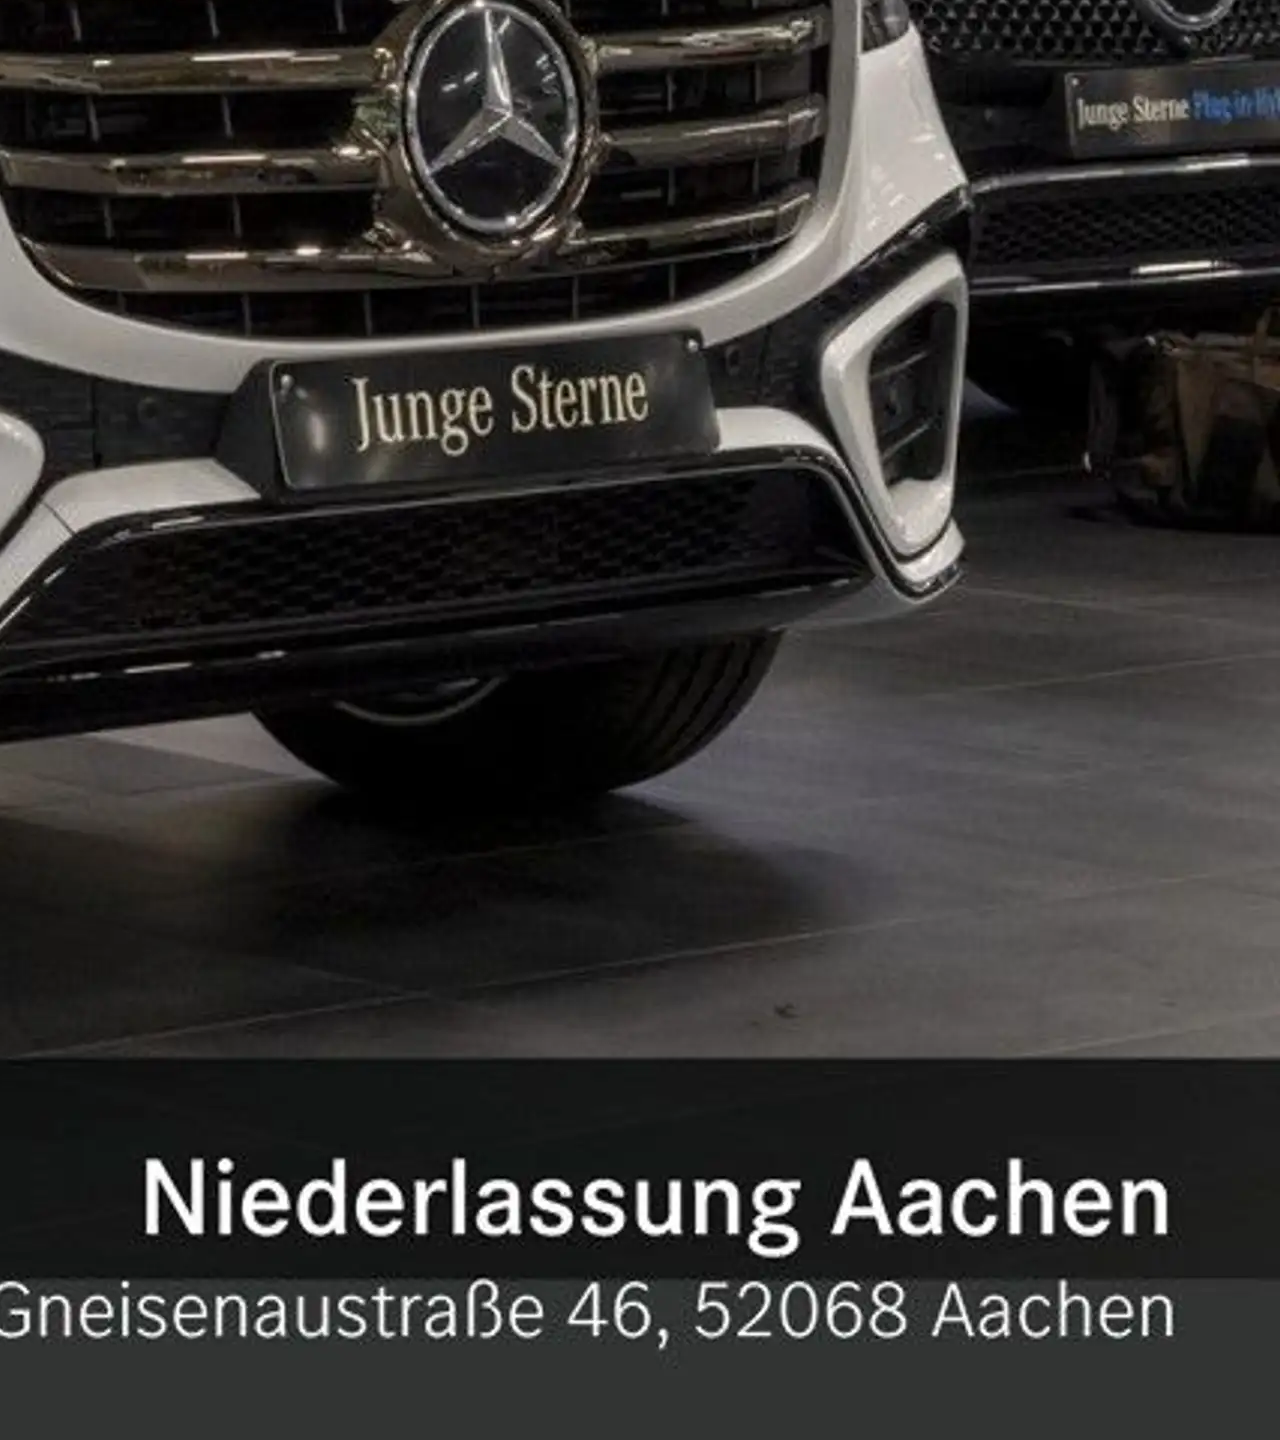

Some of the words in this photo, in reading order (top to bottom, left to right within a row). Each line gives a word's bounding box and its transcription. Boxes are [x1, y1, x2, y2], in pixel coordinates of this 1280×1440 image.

[1076, 97, 1129, 131] Junge
[1132, 93, 1190, 122] Sterne
[352, 377, 494, 457] Junge
[511, 365, 649, 433] Sterne
